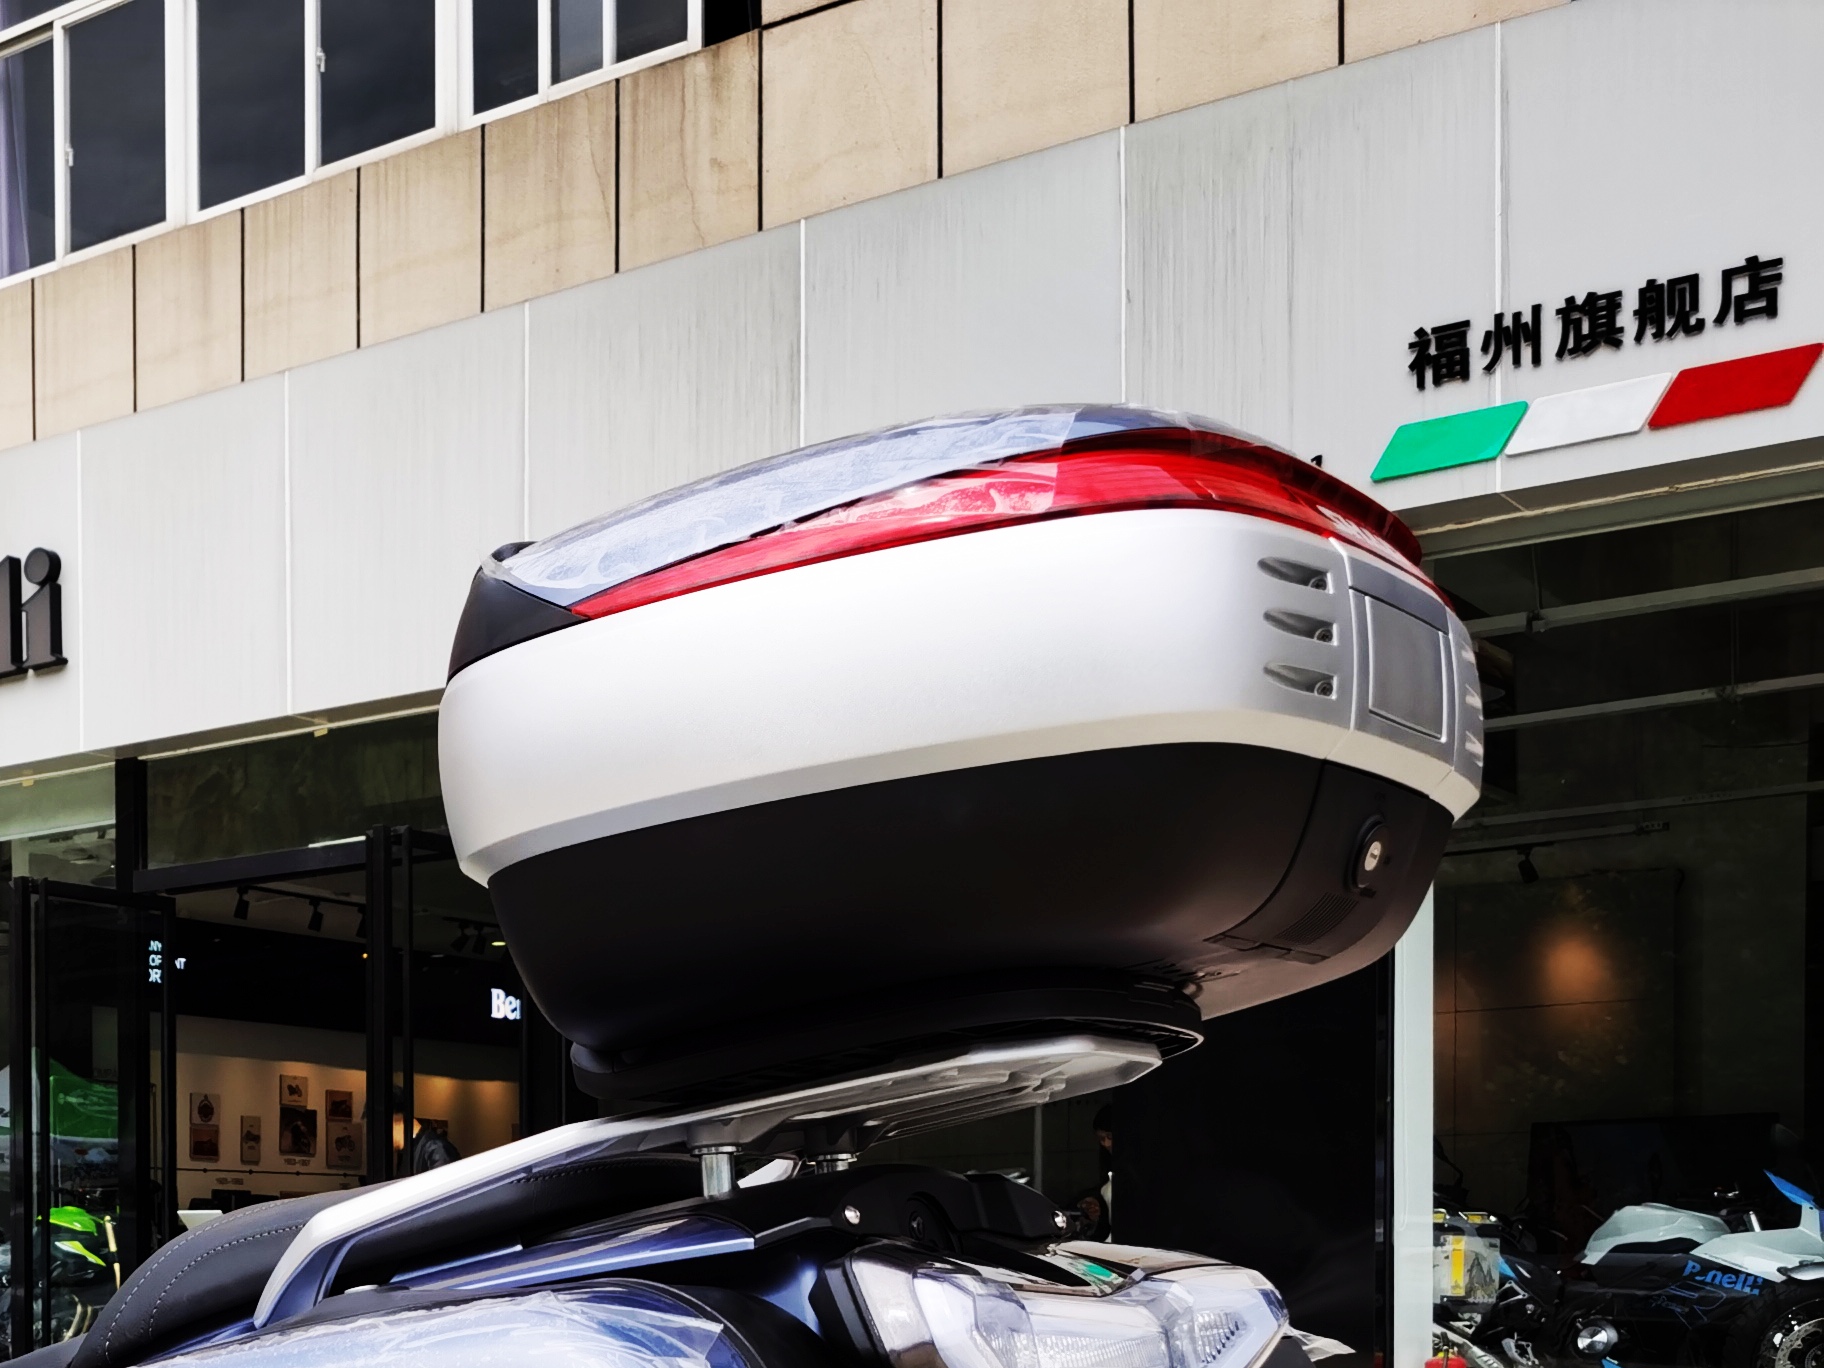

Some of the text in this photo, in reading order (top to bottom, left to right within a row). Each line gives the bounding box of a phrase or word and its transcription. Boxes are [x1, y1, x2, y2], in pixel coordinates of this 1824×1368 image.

[1408, 255, 1783, 390] 福州旗舰店
